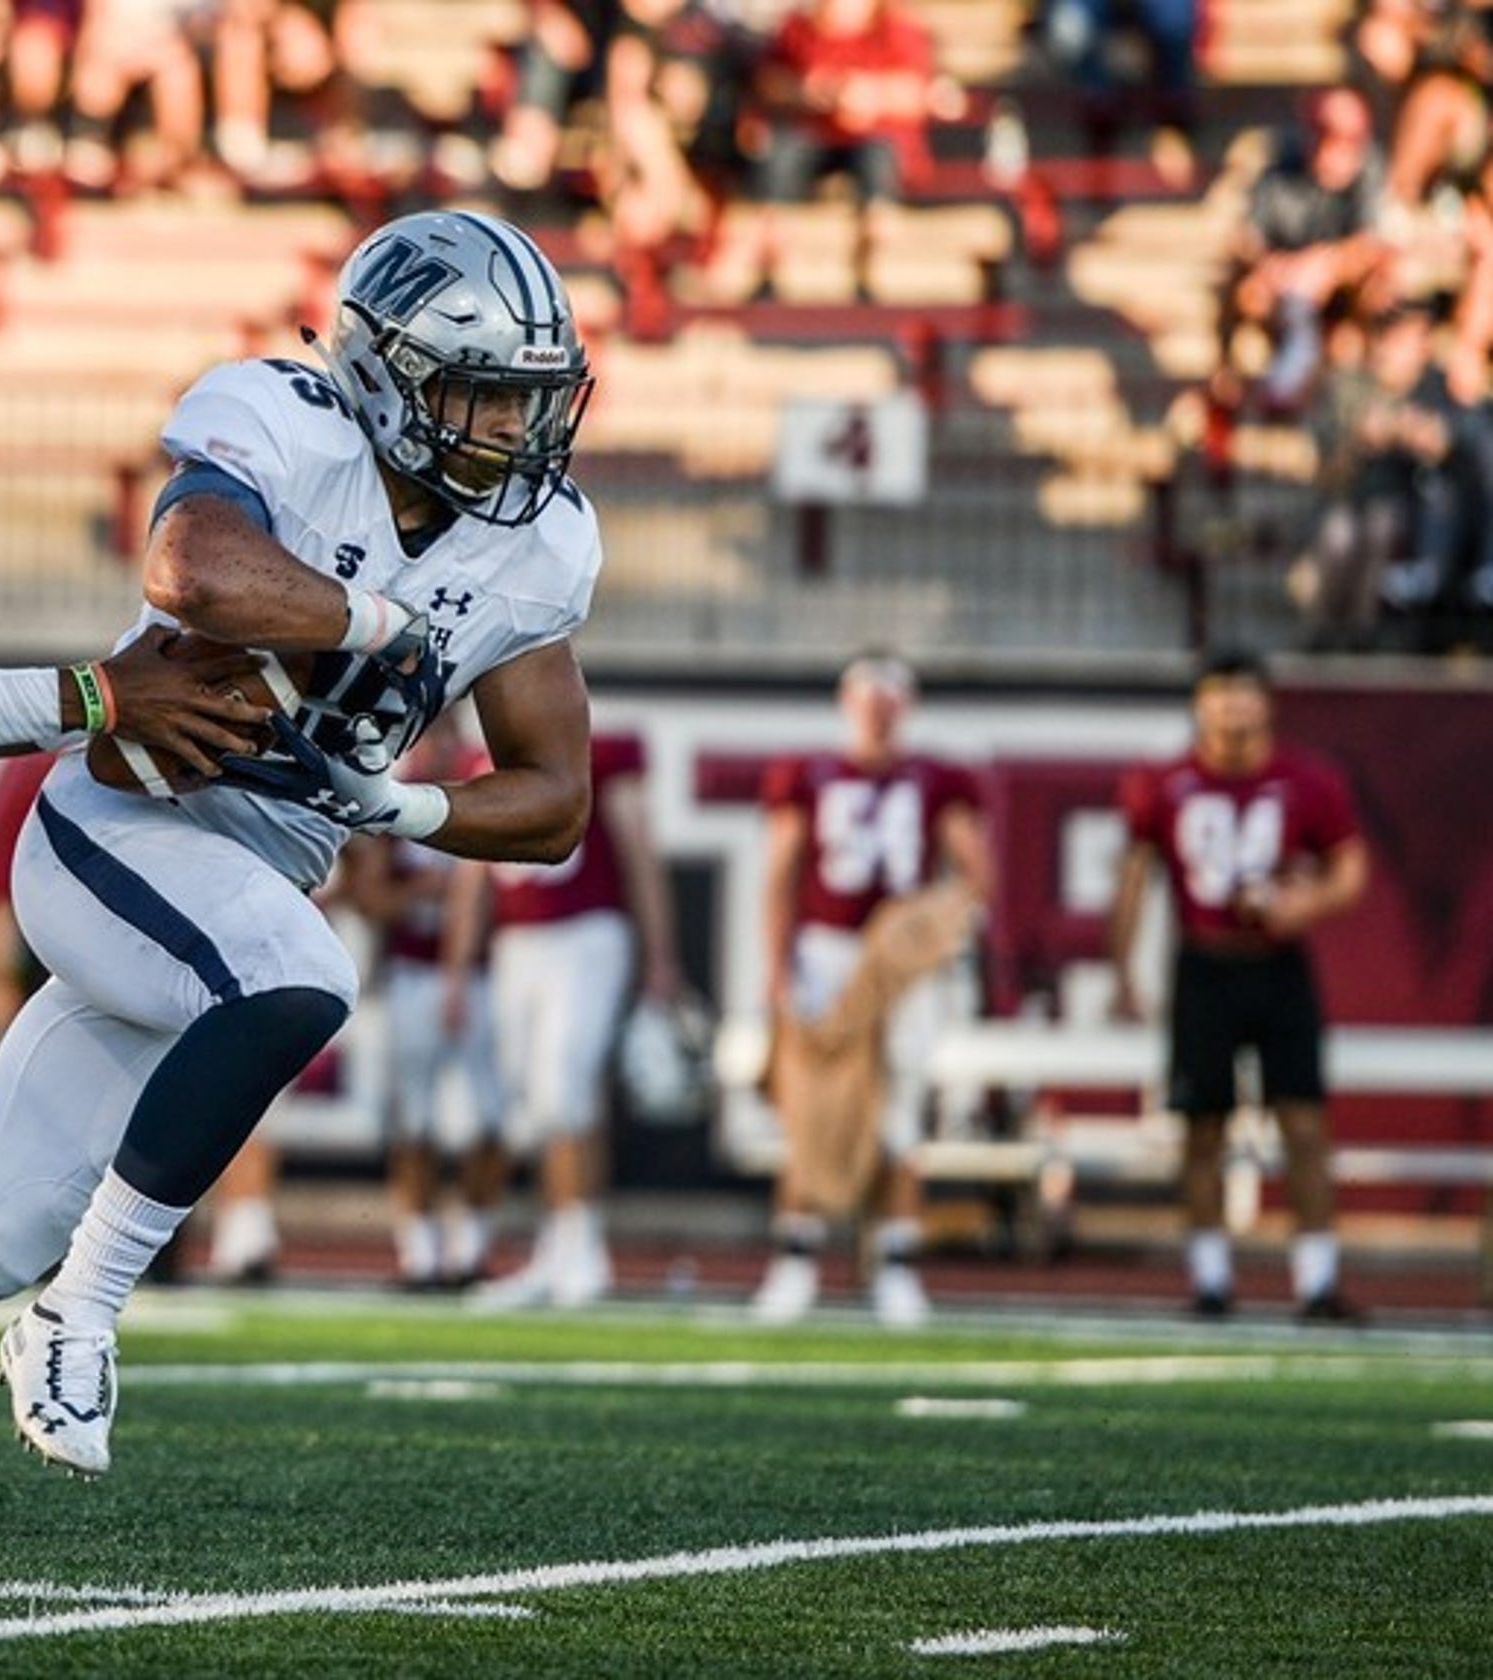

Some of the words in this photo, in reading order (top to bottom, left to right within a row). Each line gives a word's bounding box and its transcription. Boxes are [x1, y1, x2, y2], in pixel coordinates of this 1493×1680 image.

[350, 234, 464, 327] M
[521, 349, 568, 366] Riddell
[815, 779, 924, 894] 54
